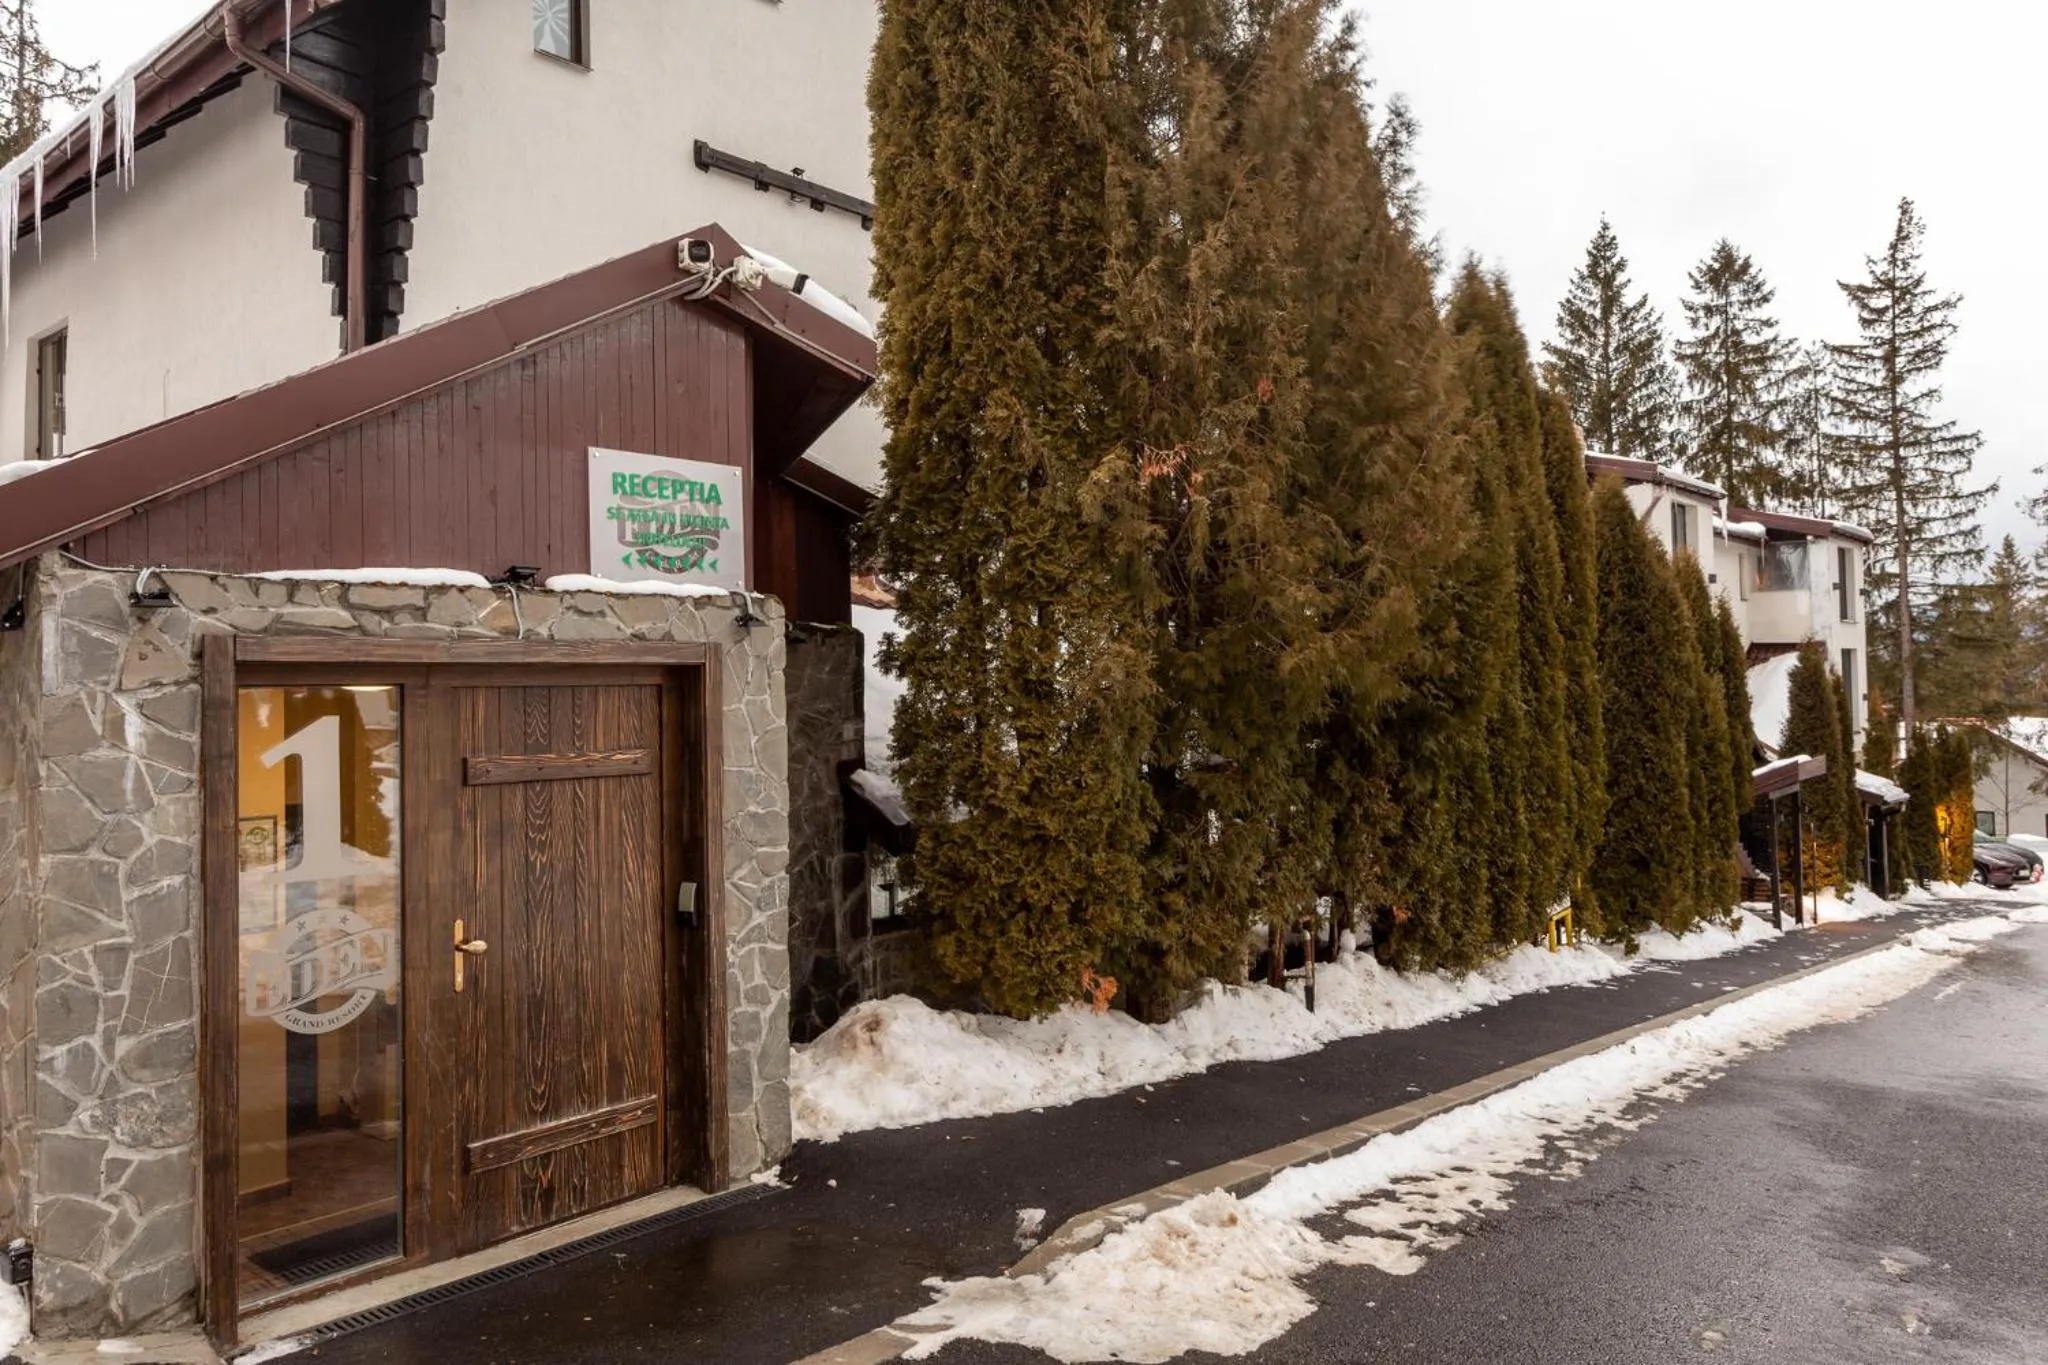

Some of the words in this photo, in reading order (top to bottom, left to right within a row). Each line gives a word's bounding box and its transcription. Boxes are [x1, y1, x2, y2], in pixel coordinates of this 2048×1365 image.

[611, 471, 722, 505] RECEPTIA
[260, 715, 371, 881] 1
[254, 934, 391, 1005] EDEN
[284, 1013, 324, 1029] GRAND
[327, 994, 367, 1026] RESORT
